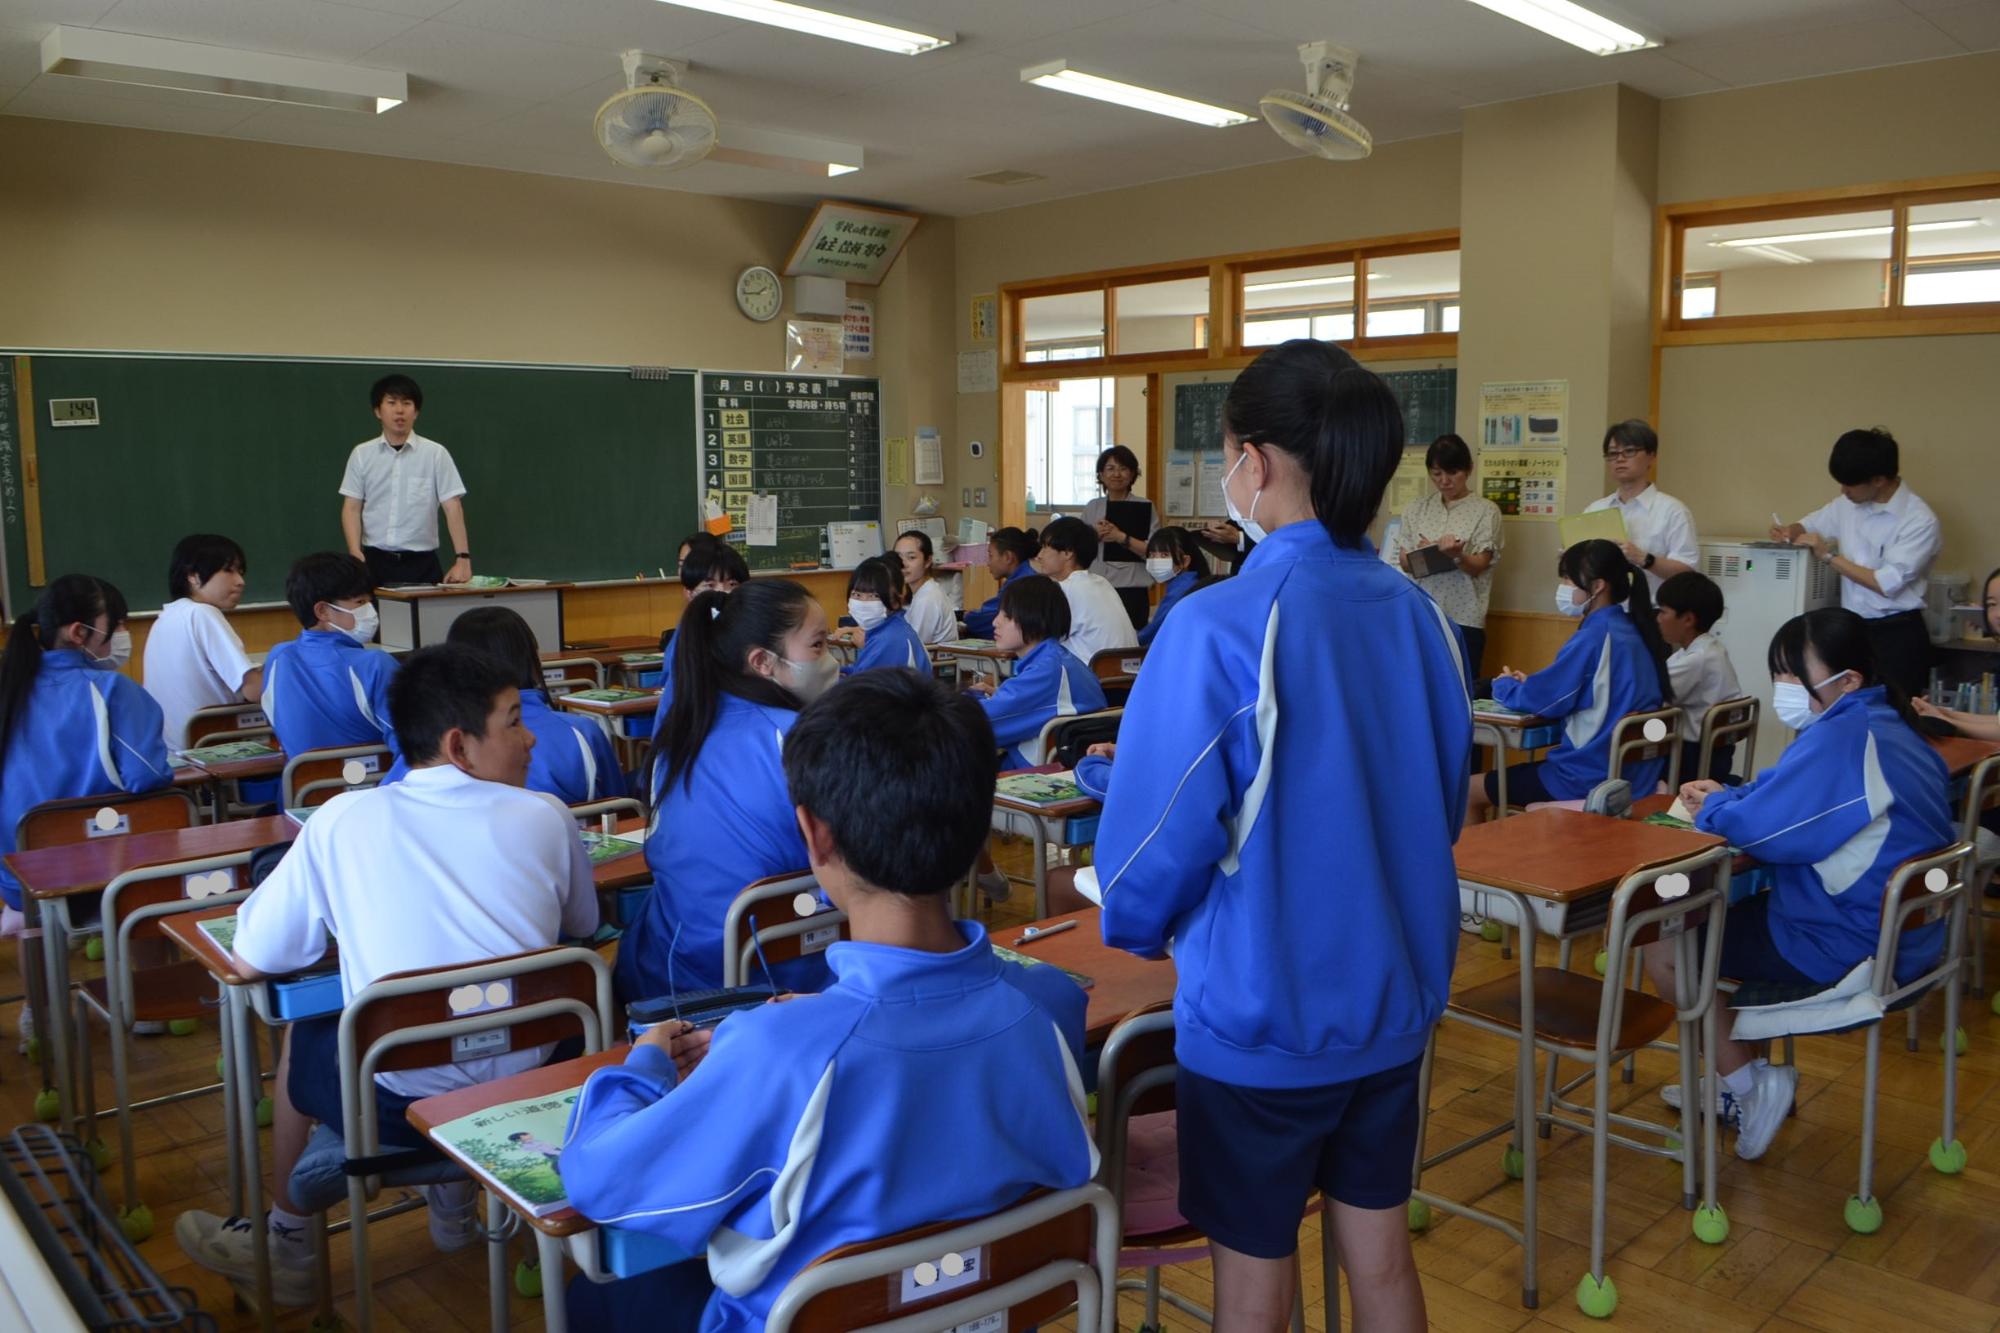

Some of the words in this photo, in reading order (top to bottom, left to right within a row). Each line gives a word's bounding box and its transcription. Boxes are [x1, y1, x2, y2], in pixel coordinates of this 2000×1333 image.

[720, 379, 730, 391] 月
[708, 413, 715, 426] 1
[726, 413, 745, 425] 社会
[707, 434, 717, 446] 2
[727, 433, 746, 445] 英語
[708, 454, 718, 466] 3
[728, 454, 748, 465] 数学
[708, 474, 718, 486] 4
[728, 474, 748, 485] 国語
[474, 1100, 562, 1128] 新しい道徳
